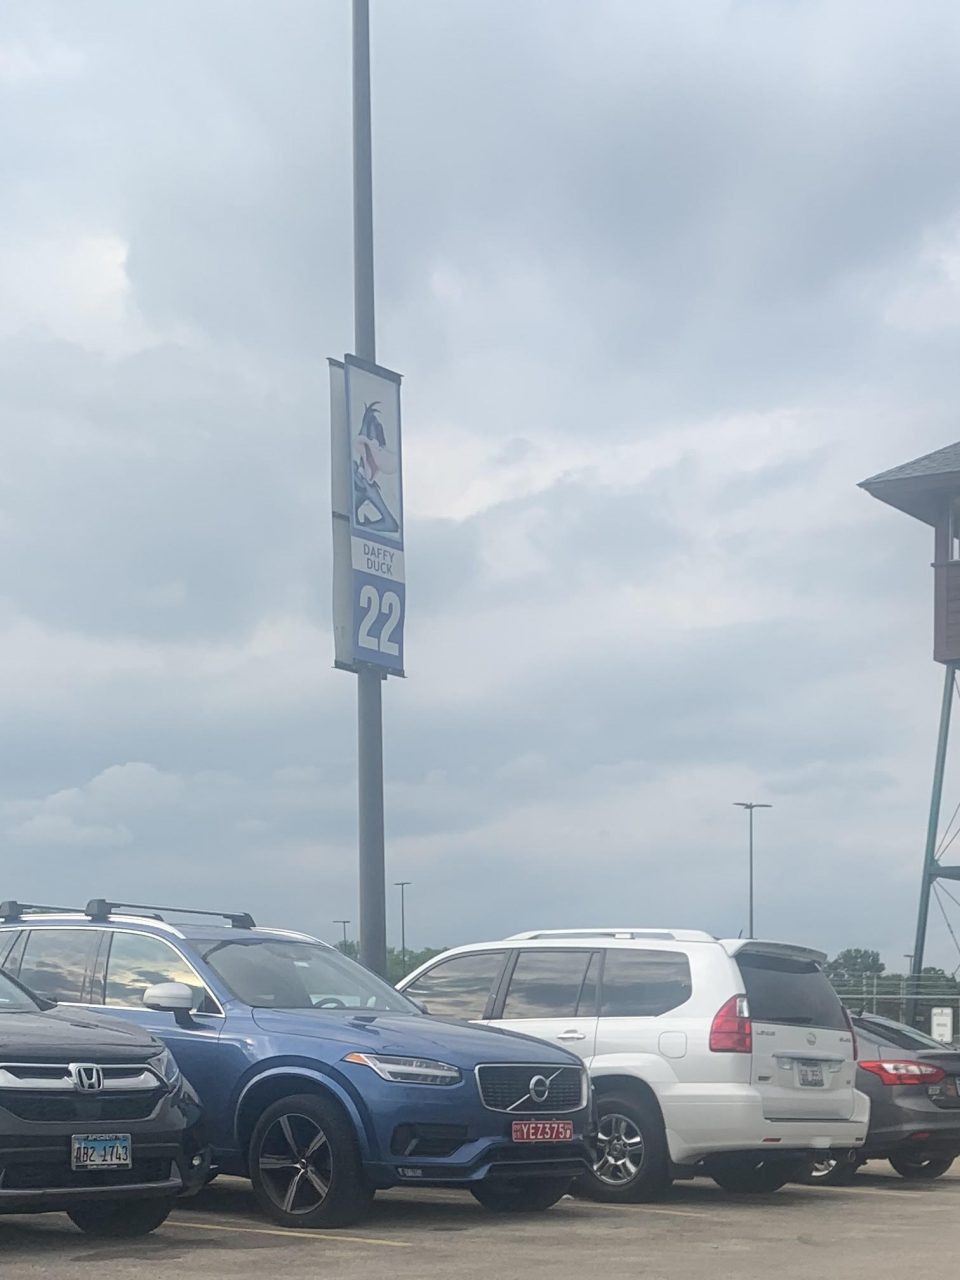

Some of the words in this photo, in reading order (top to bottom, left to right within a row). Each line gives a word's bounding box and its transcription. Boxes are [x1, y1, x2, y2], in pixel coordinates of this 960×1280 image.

[363, 543, 395, 564] DAFFY
[366, 558, 394, 576] DUCK
[358, 585, 401, 656] 22
